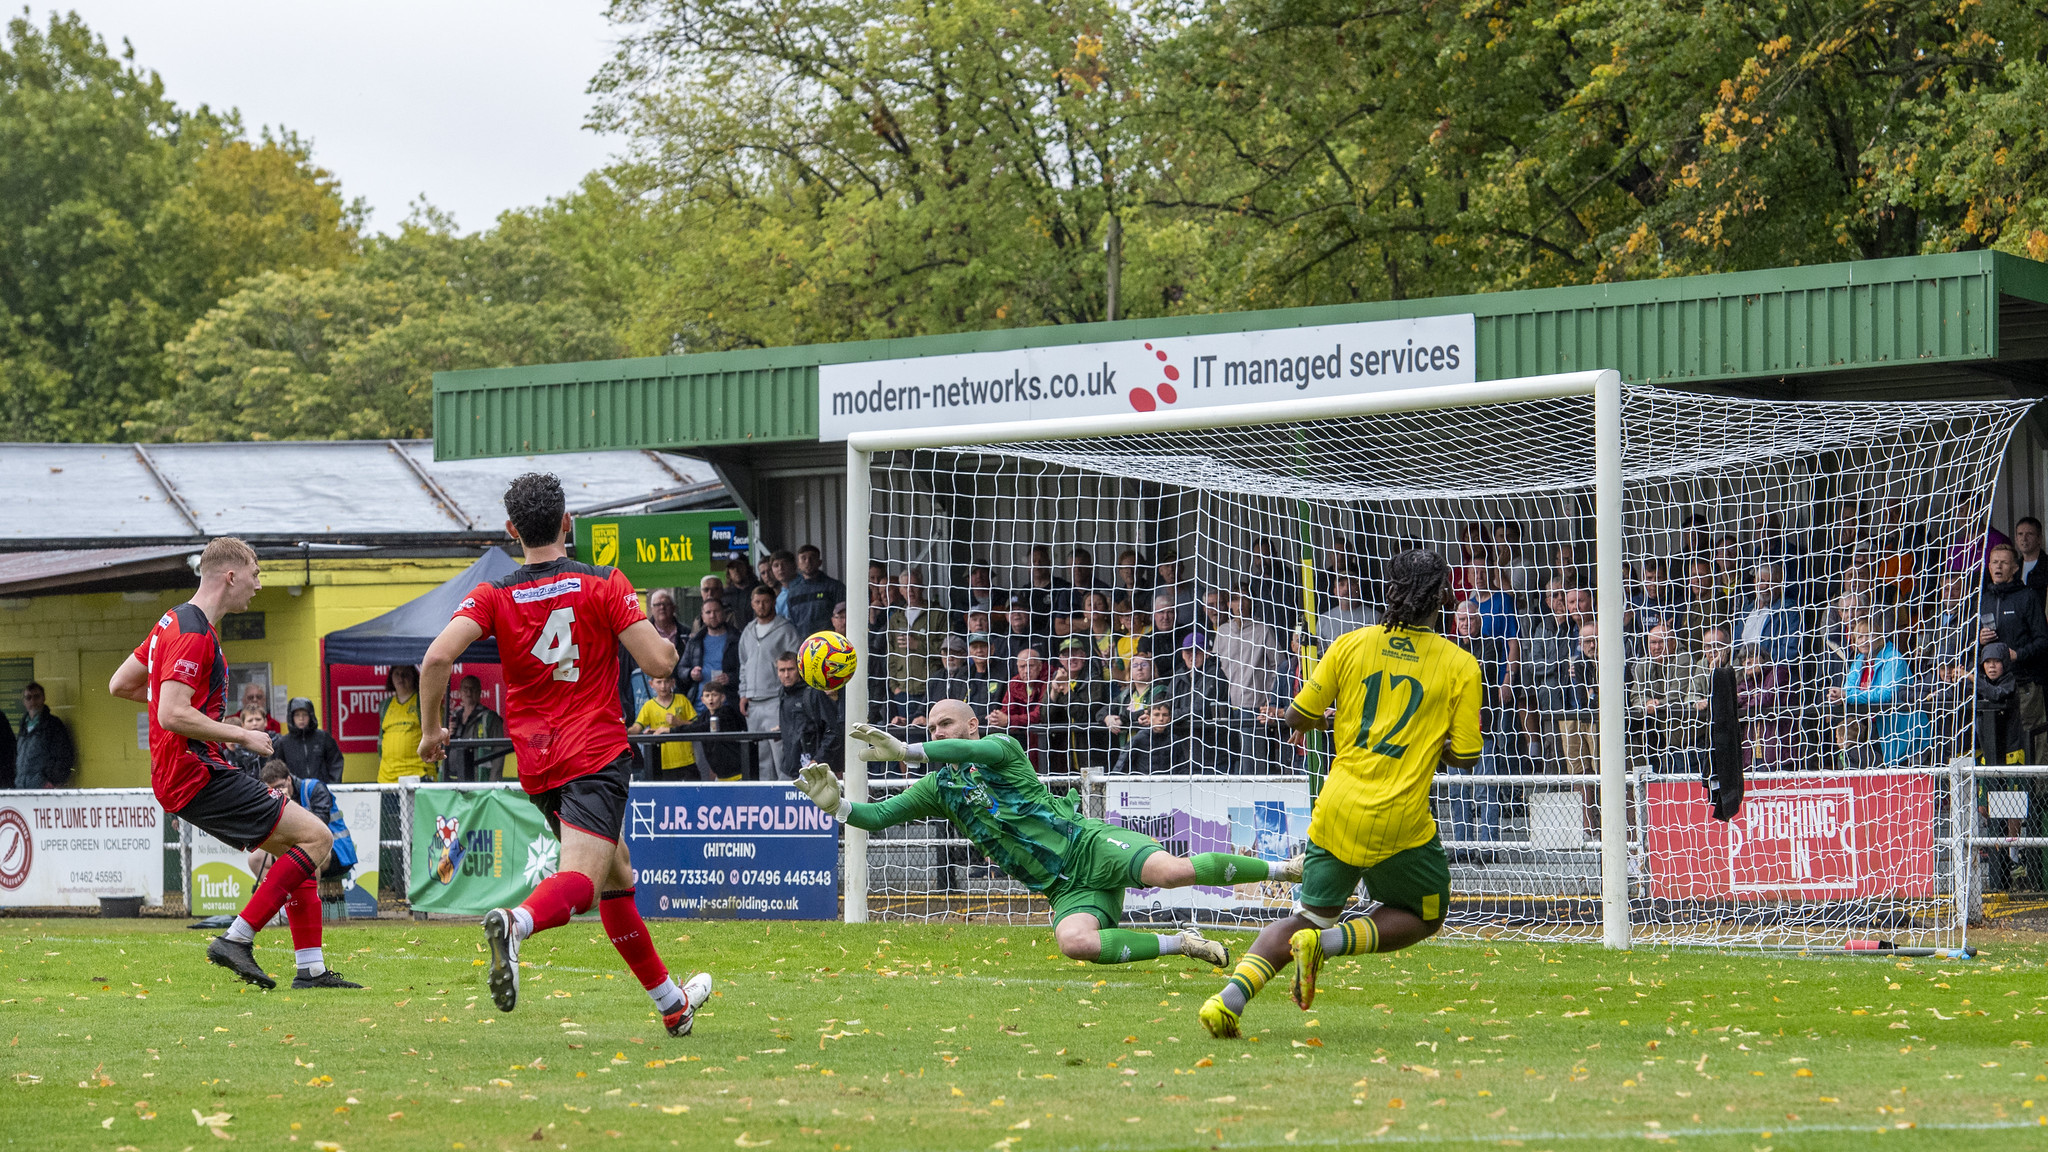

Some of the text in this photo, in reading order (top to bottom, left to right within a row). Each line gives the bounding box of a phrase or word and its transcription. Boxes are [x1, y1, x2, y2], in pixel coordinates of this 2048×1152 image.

[1193, 339, 1461, 392] IT managed services
[832, 362, 1117, 417] modern-networks.co.uk
[712, 530, 731, 540] Arena
[636, 534, 693, 563] No Exit
[530, 606, 580, 683] 4
[1353, 669, 1424, 760] 12
[785, 791, 797, 801] KIM
[33, 806, 156, 829] THE PLUME OF FEATHERS
[659, 805, 832, 831] J.R. SCAFFOLDING
[1121, 815, 1174, 838] DISCOVER
[1746, 800, 1836, 840] PITCHING
[41, 838, 151, 851] UPPER GREEN ICKLEFORD
[494, 829, 503, 878] HITCHIN
[703, 842, 756, 859] (HITCHIN)
[462, 853, 494, 877] CUP
[1790, 836, 1811, 879] IN
[70, 871, 122, 883] 01462 455953
[198, 874, 240, 898] Turtle
[641, 869, 677, 885] 01462
[680, 869, 725, 885] 733340
[742, 869, 780, 885] 07496
[783, 870, 831, 886] 446348
[203, 902, 236, 911] MORTGAGES
[671, 896, 799, 912] www.jr-scaffolding.co.uk
[611, 931, 639, 943] KTFC
